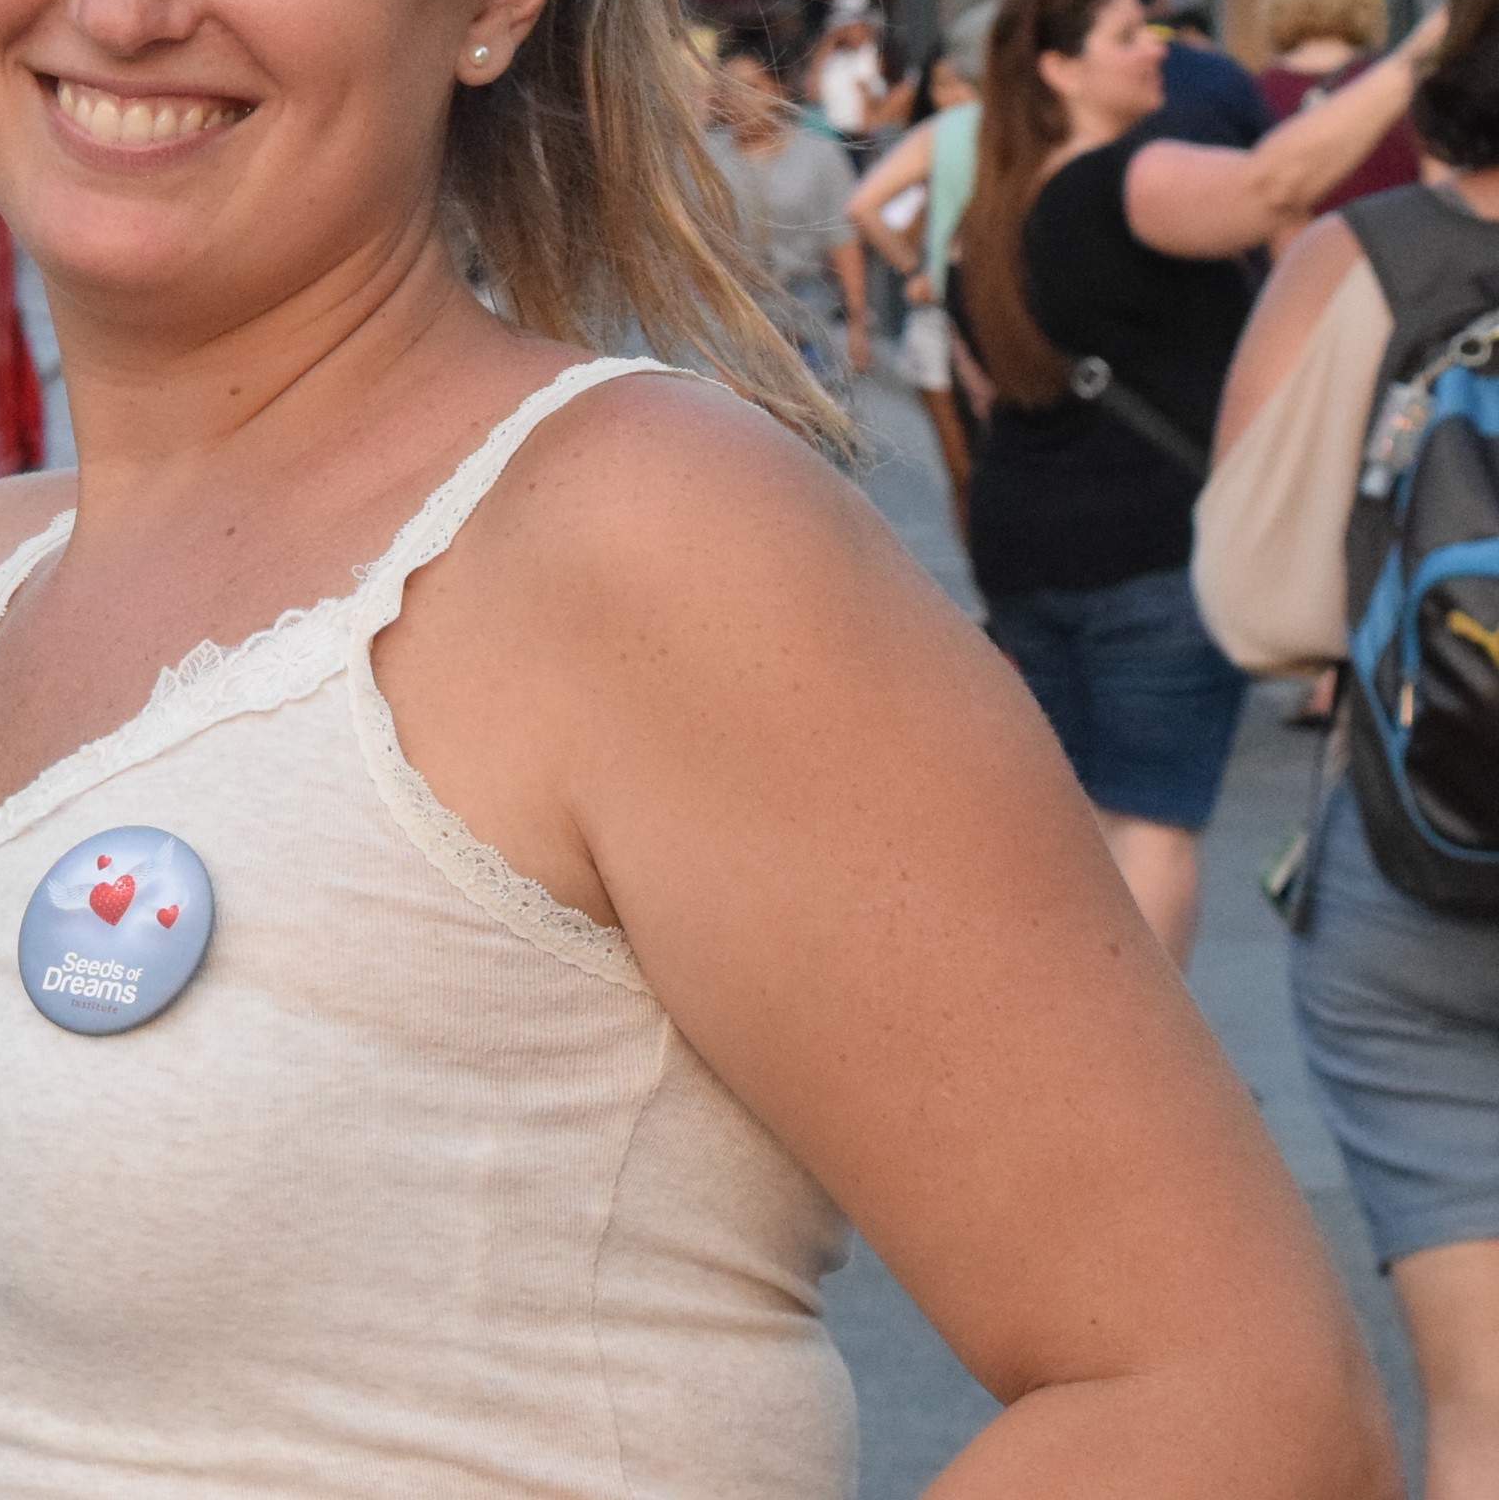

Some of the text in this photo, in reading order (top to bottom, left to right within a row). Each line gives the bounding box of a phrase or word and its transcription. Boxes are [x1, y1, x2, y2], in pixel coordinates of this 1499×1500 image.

[62, 952, 125, 980] Seeds
[42, 966, 138, 1005] Dreams
[70, 998, 120, 1014] Institute
